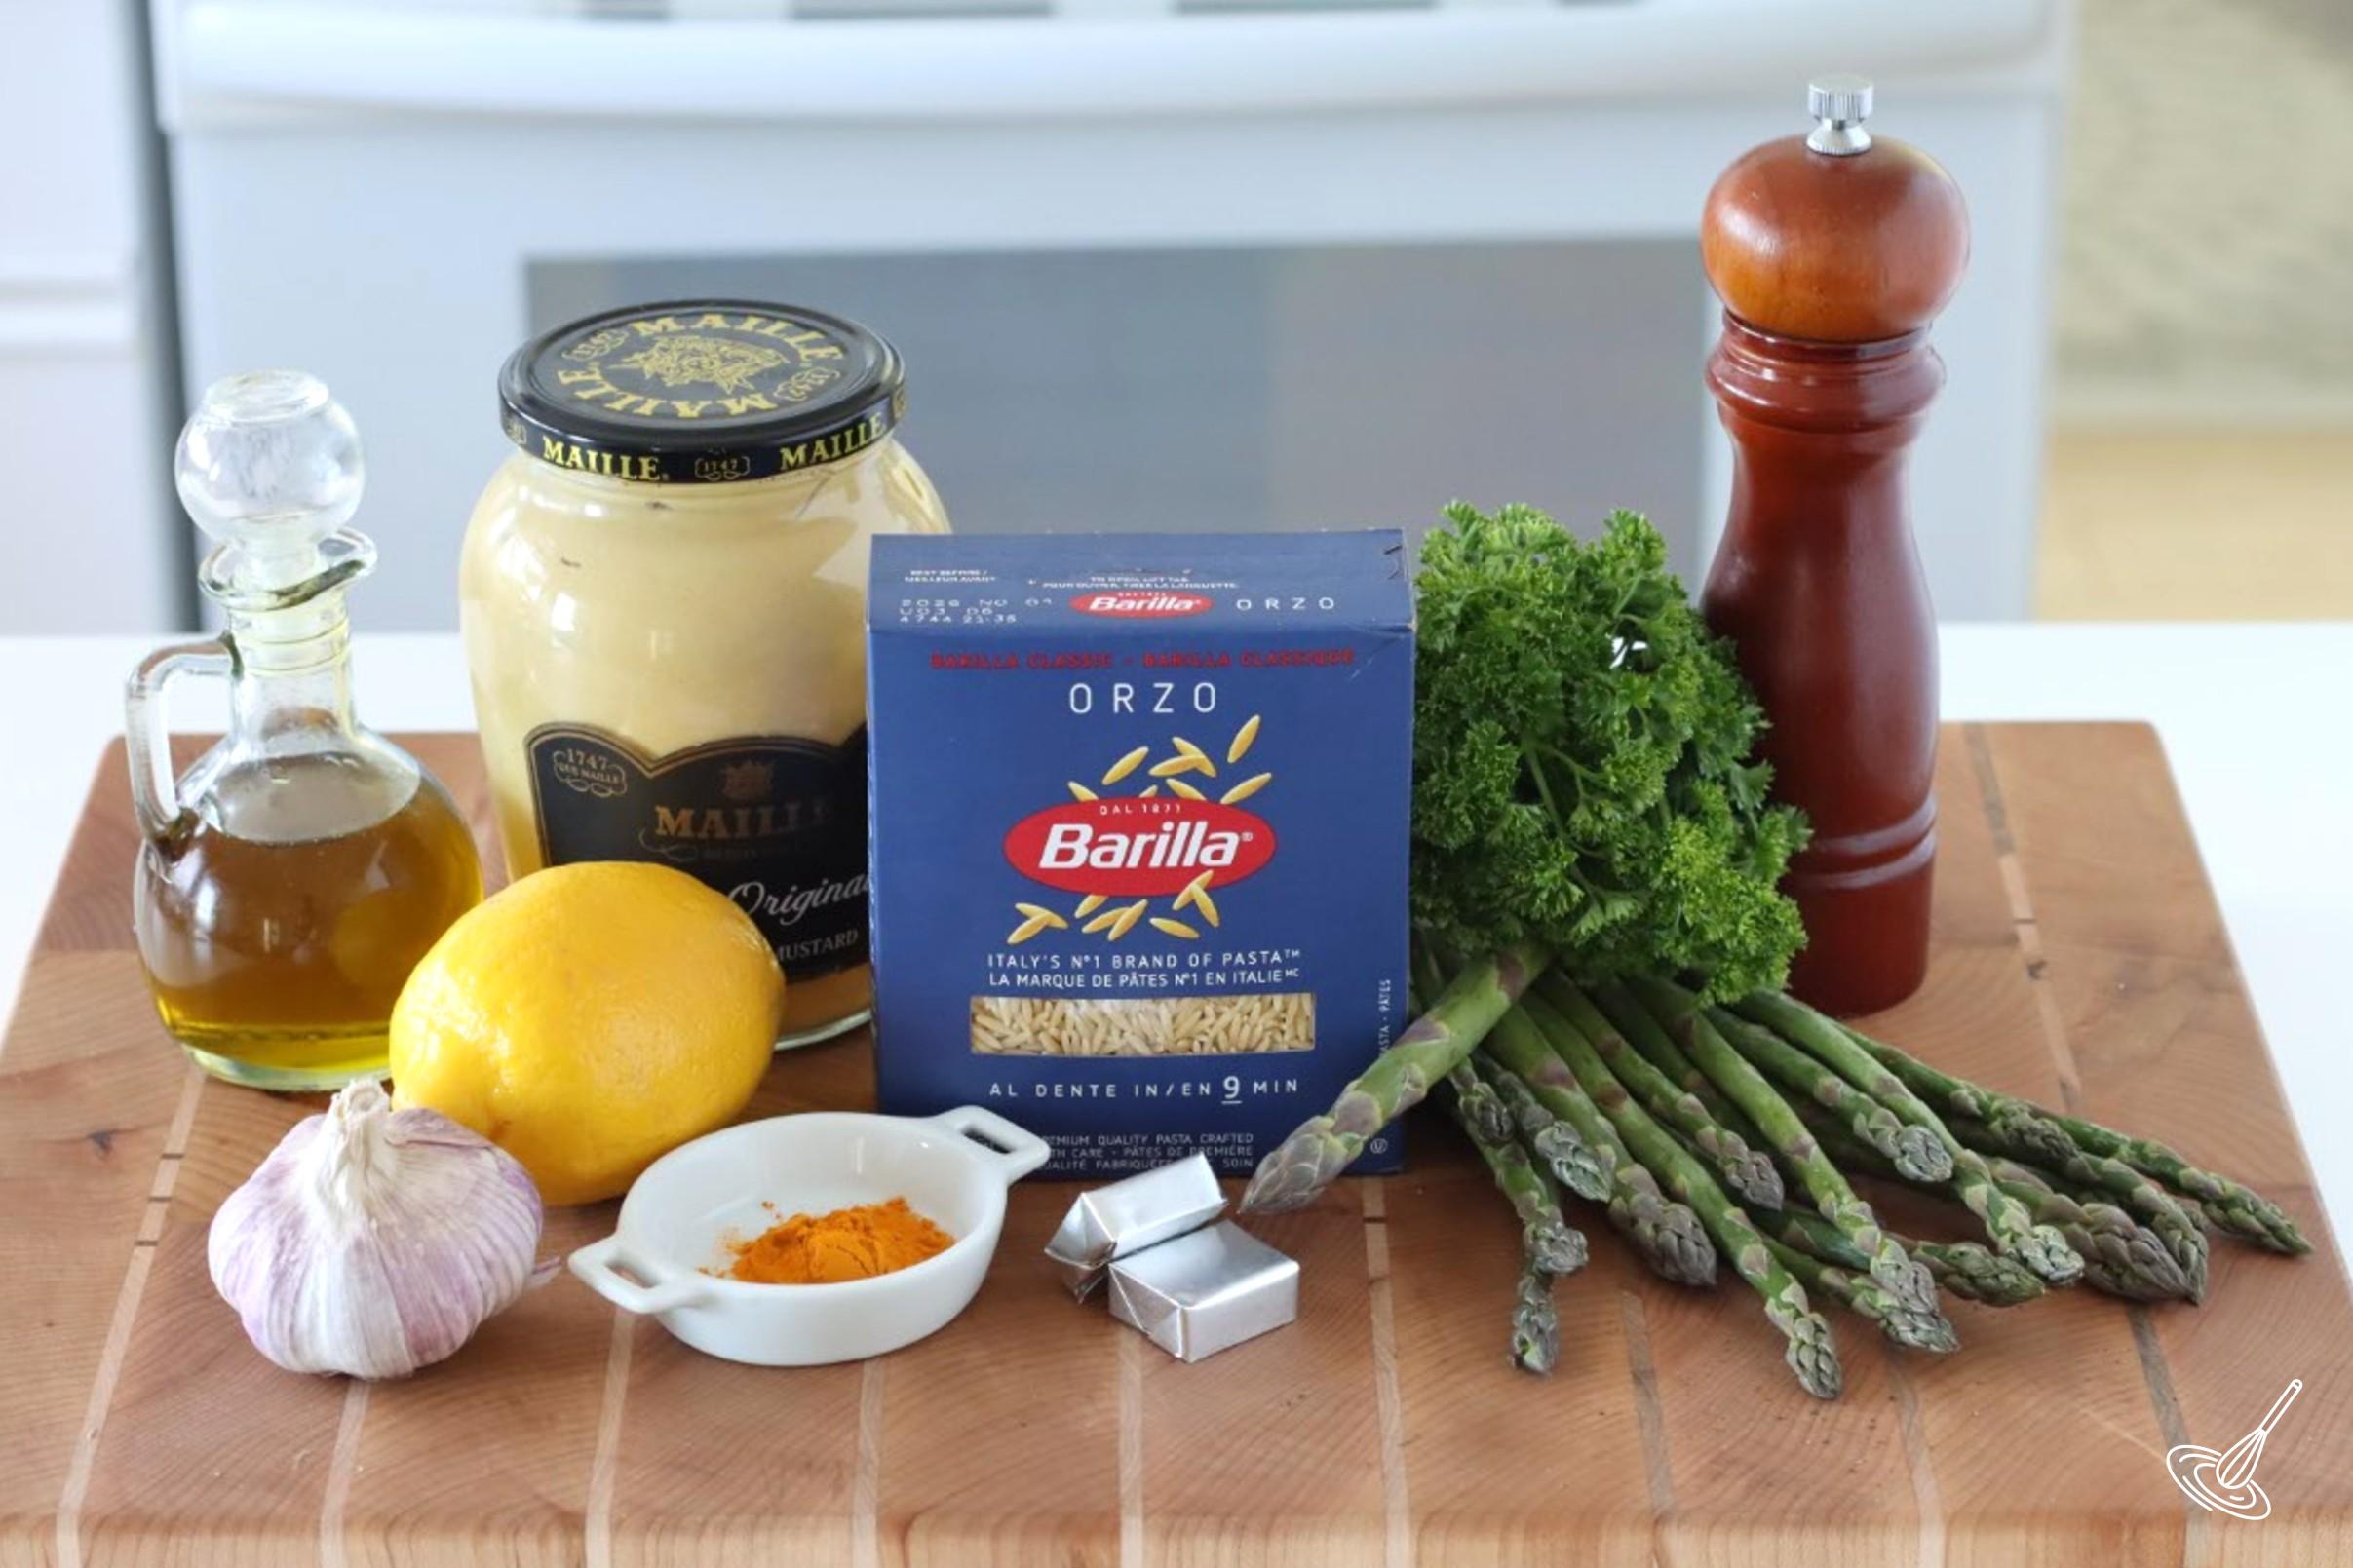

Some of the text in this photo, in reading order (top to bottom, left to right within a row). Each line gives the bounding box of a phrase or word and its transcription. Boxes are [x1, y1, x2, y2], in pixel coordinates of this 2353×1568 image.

[629, 313, 844, 360] MAILLE
[542, 435, 661, 481] MAILLE
[779, 412, 885, 471] MAILLE
[1088, 596, 1194, 611] Barilla
[1235, 596, 1335, 610] ORZO
[1068, 682, 1217, 713] ORZO
[566, 747, 609, 770] 1747
[1038, 821, 1241, 869] Barilla
[728, 873, 868, 926] Origina
[986, 953, 1061, 969] ITALY'S
[1112, 953, 1177, 969] BRAND
[1188, 952, 1213, 968] OF
[989, 972, 1010, 986] LA
[1016, 974, 1085, 989] MARQUE
[1091, 975, 1113, 988] DE
[1119, 972, 1168, 987] PÂTES
[1205, 972, 1226, 986] EN
[1377, 1025, 1391, 1054] ASTA
[989, 1082, 1018, 1096] AL
[1035, 1083, 1117, 1097] DENTE
[1222, 1075, 1241, 1100] 9
[1253, 1078, 1297, 1094] MIN
[1043, 1133, 1254, 1146] EMIUM QUALITY PASTA CRAFTED
[1072, 1148, 1103, 1158] CARE
[1167, 1147, 1183, 1157] DE
[1222, 1157, 1254, 1168] SOIN
